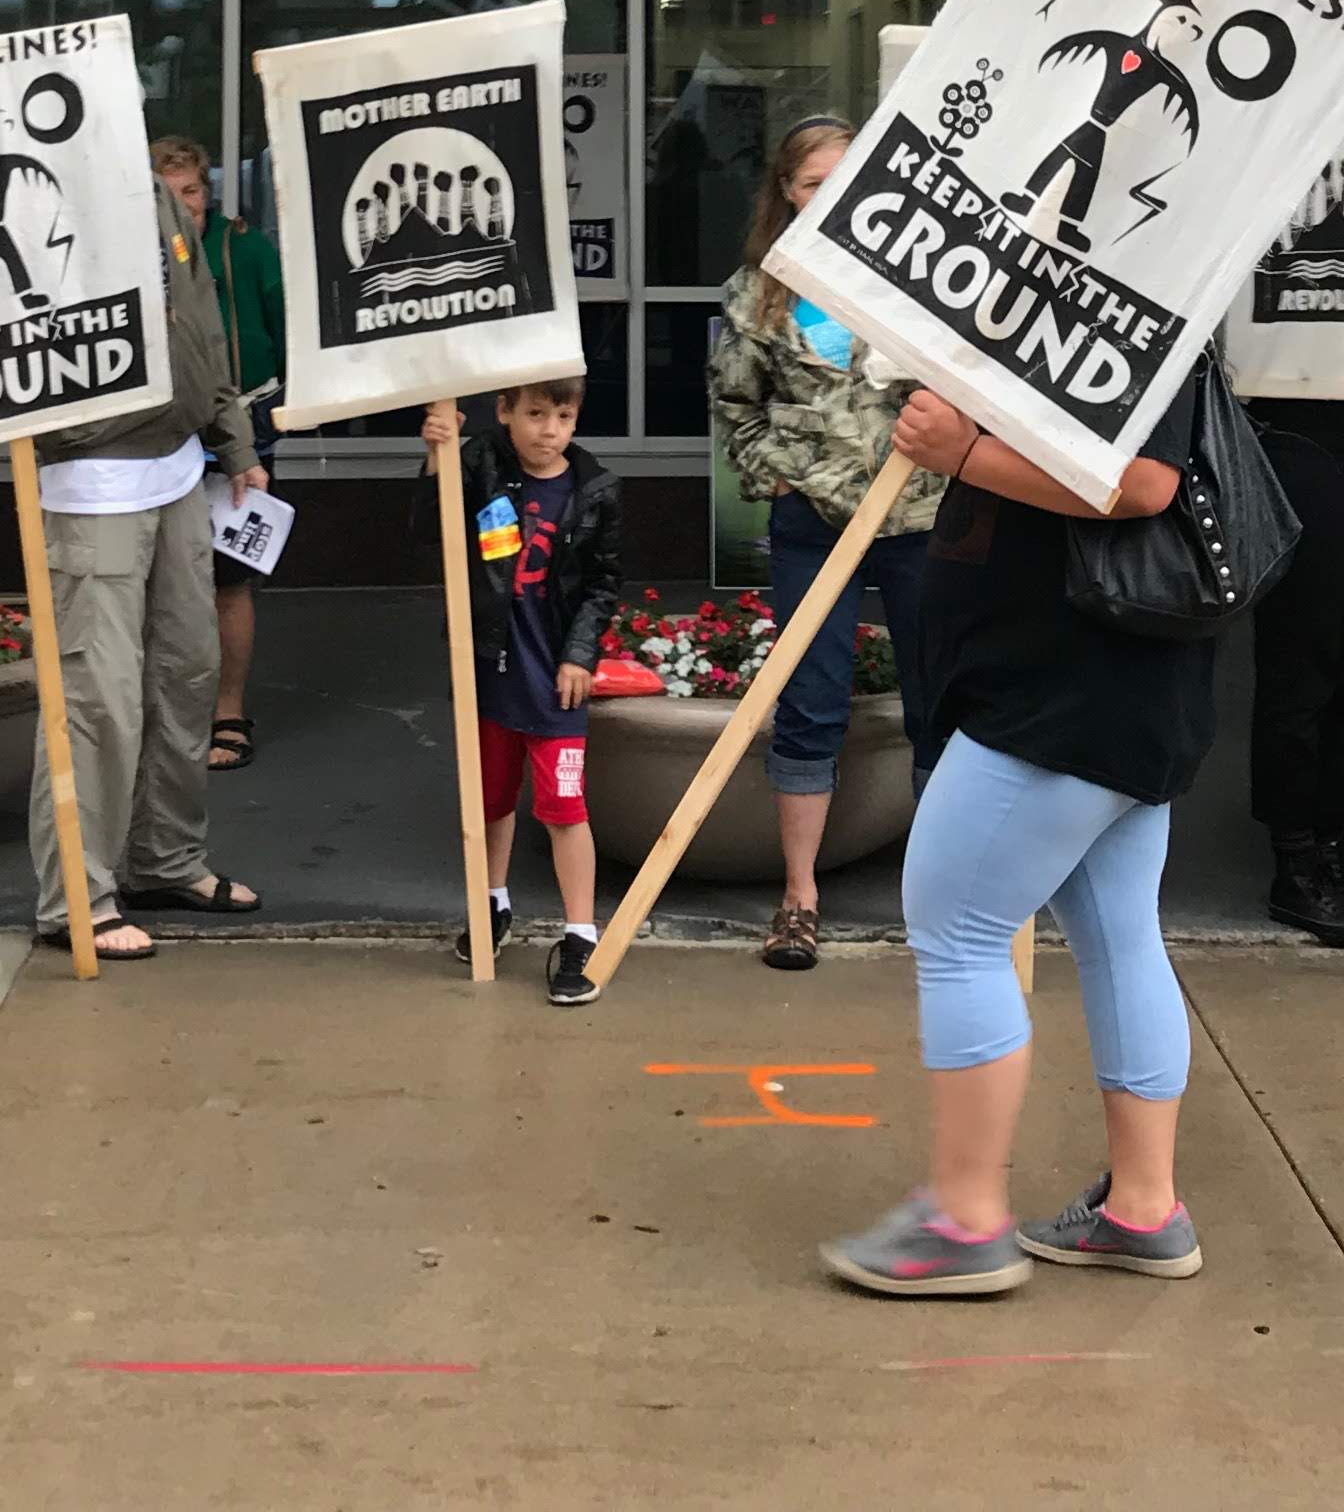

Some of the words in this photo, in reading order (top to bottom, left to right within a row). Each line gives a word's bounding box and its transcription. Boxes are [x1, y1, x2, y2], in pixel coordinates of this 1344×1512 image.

[319, 92, 431, 134] MOTHER
[436, 78, 521, 113] EARTH
[886, 142, 983, 218] KEEP
[984, 210, 1022, 251] IT
[1017, 240, 1073, 289] IN
[1077, 274, 1160, 352] THE
[11, 318, 49, 345] IN
[58, 302, 129, 337] THE
[356, 284, 516, 333] REVOLUTION
[851, 192, 1131, 404] GROUND
